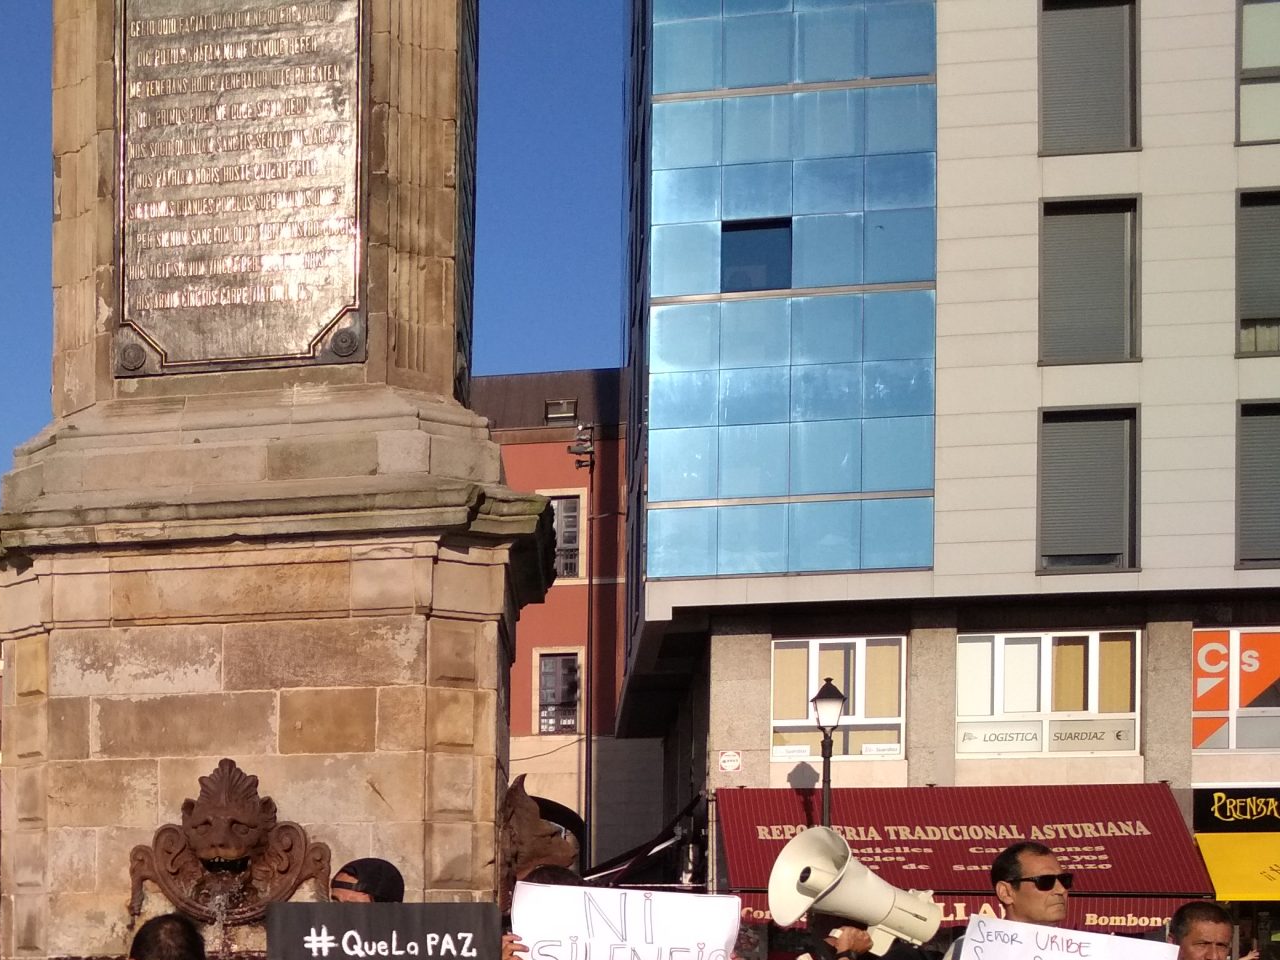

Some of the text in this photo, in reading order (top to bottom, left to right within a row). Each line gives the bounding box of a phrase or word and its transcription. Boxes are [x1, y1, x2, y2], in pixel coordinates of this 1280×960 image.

[983, 731, 1106, 743] LOGISTICA SUARDIAZ
[884, 824, 1025, 841] TRADICIONAL
[1030, 820, 1152, 840] ASTURIANA
[426, 932, 478, 958] PAZ
[1035, 931, 1092, 957] URIBE
